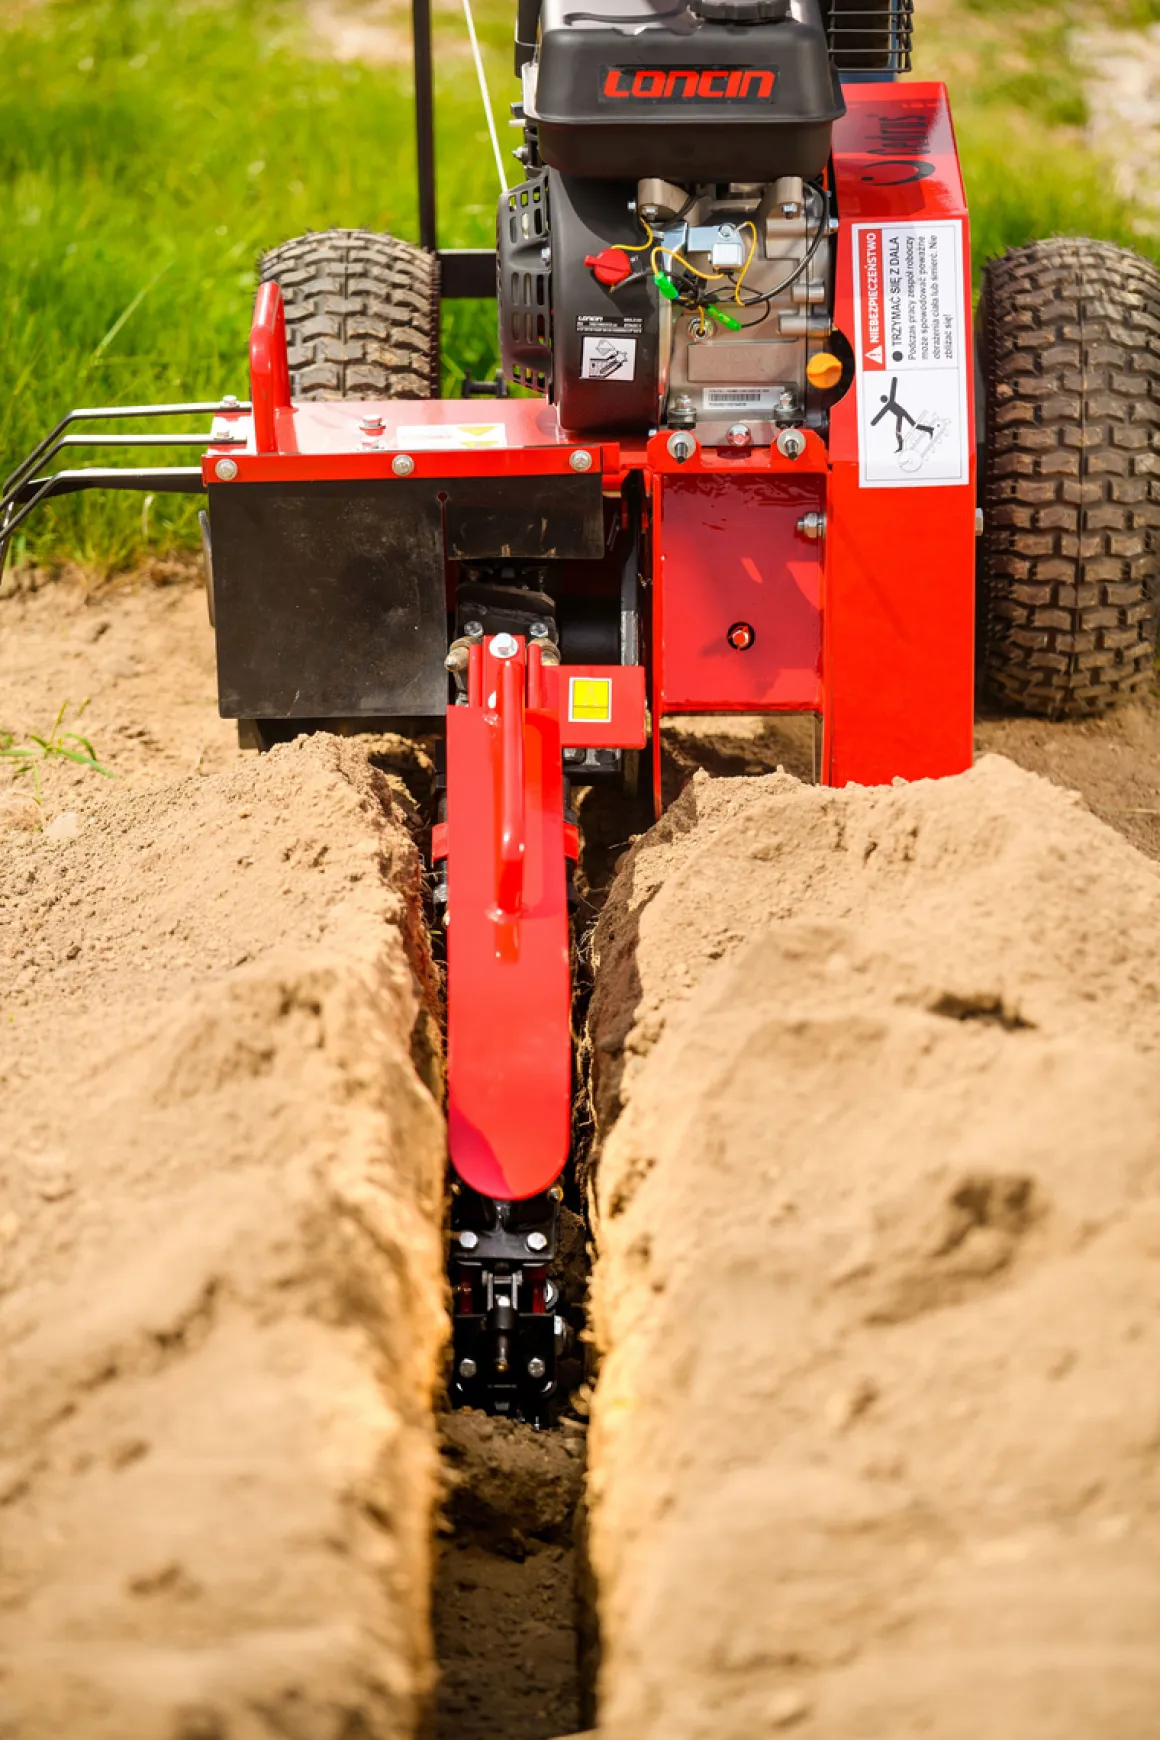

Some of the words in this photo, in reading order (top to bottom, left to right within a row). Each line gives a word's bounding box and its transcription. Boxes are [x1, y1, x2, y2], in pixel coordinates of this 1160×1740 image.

[603, 70, 775, 98] LONCIN
[889, 236, 900, 266] DALA
[905, 236, 916, 269] roboczy
[917, 236, 928, 275] poważne
[929, 235, 938, 249] Nie
[890, 267, 900, 276] Z
[906, 271, 917, 298] zespół
[864, 232, 880, 343] NIEBEZPIECZEŃSTWO
[890, 277, 902, 294] SIĘ
[930, 283, 939, 297] lub
[908, 300, 918, 323] pracy
[930, 297, 940, 317] ciała
[889, 297, 902, 347] TRZYMAĆ
[908, 325, 917, 361] Podczas
[919, 337, 929, 360] może
[931, 318, 941, 360] obrażenia
